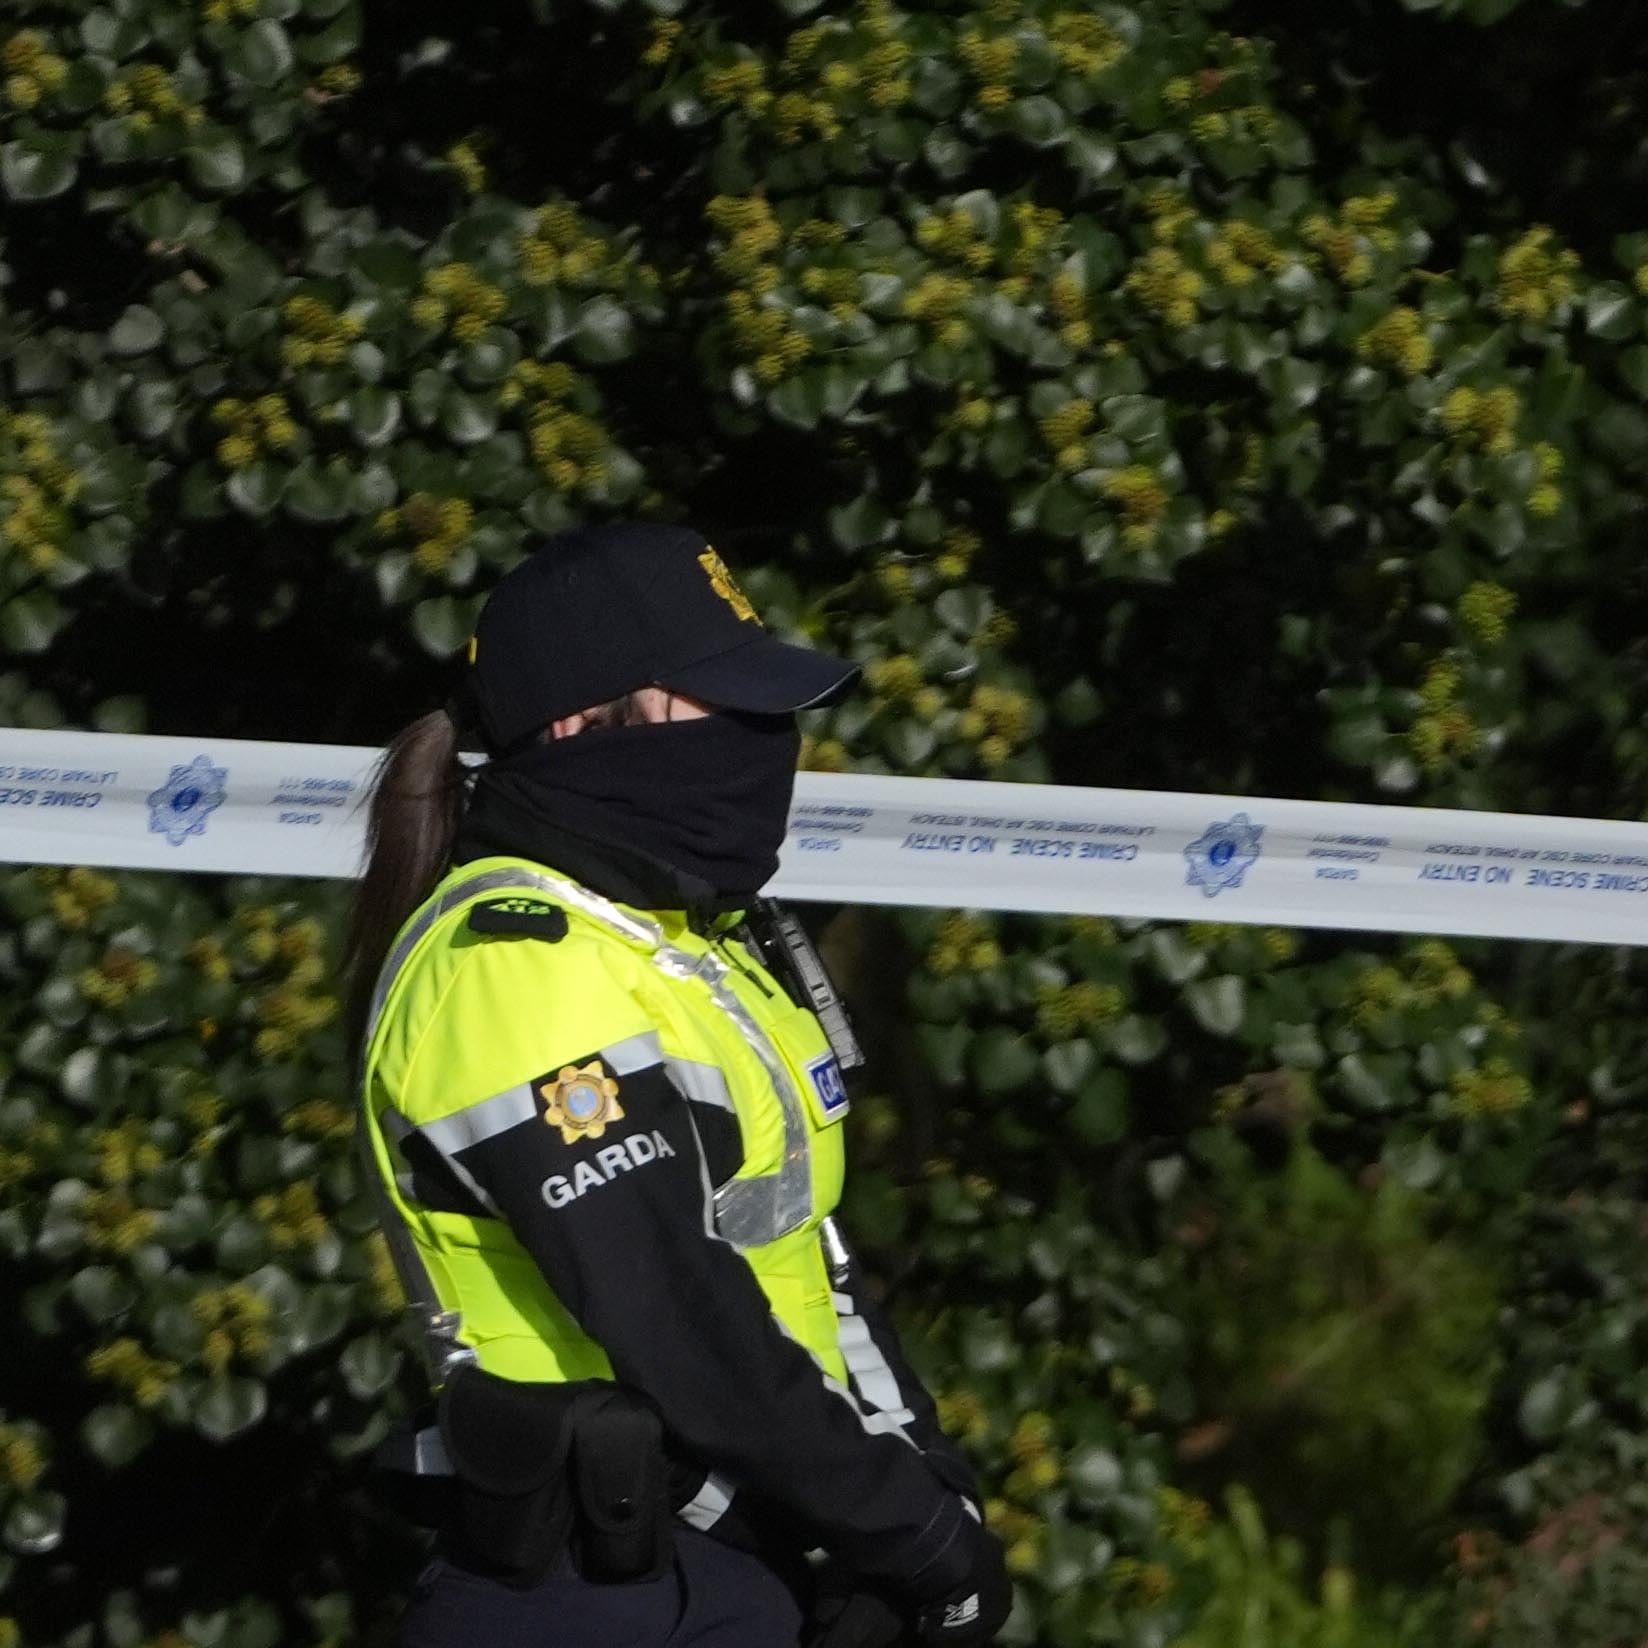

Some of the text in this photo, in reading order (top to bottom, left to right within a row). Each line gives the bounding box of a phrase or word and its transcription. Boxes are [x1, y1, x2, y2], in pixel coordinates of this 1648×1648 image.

[0, 788, 103, 808] CRIME SCE
[900, 833, 1138, 862] CRIME SCENE NO ENTRY
[1417, 863, 1481, 883] ENTRY
[1484, 866, 1513, 885] NO
[1525, 868, 1591, 890] SCENE
[541, 1130, 676, 1209] GARDA
